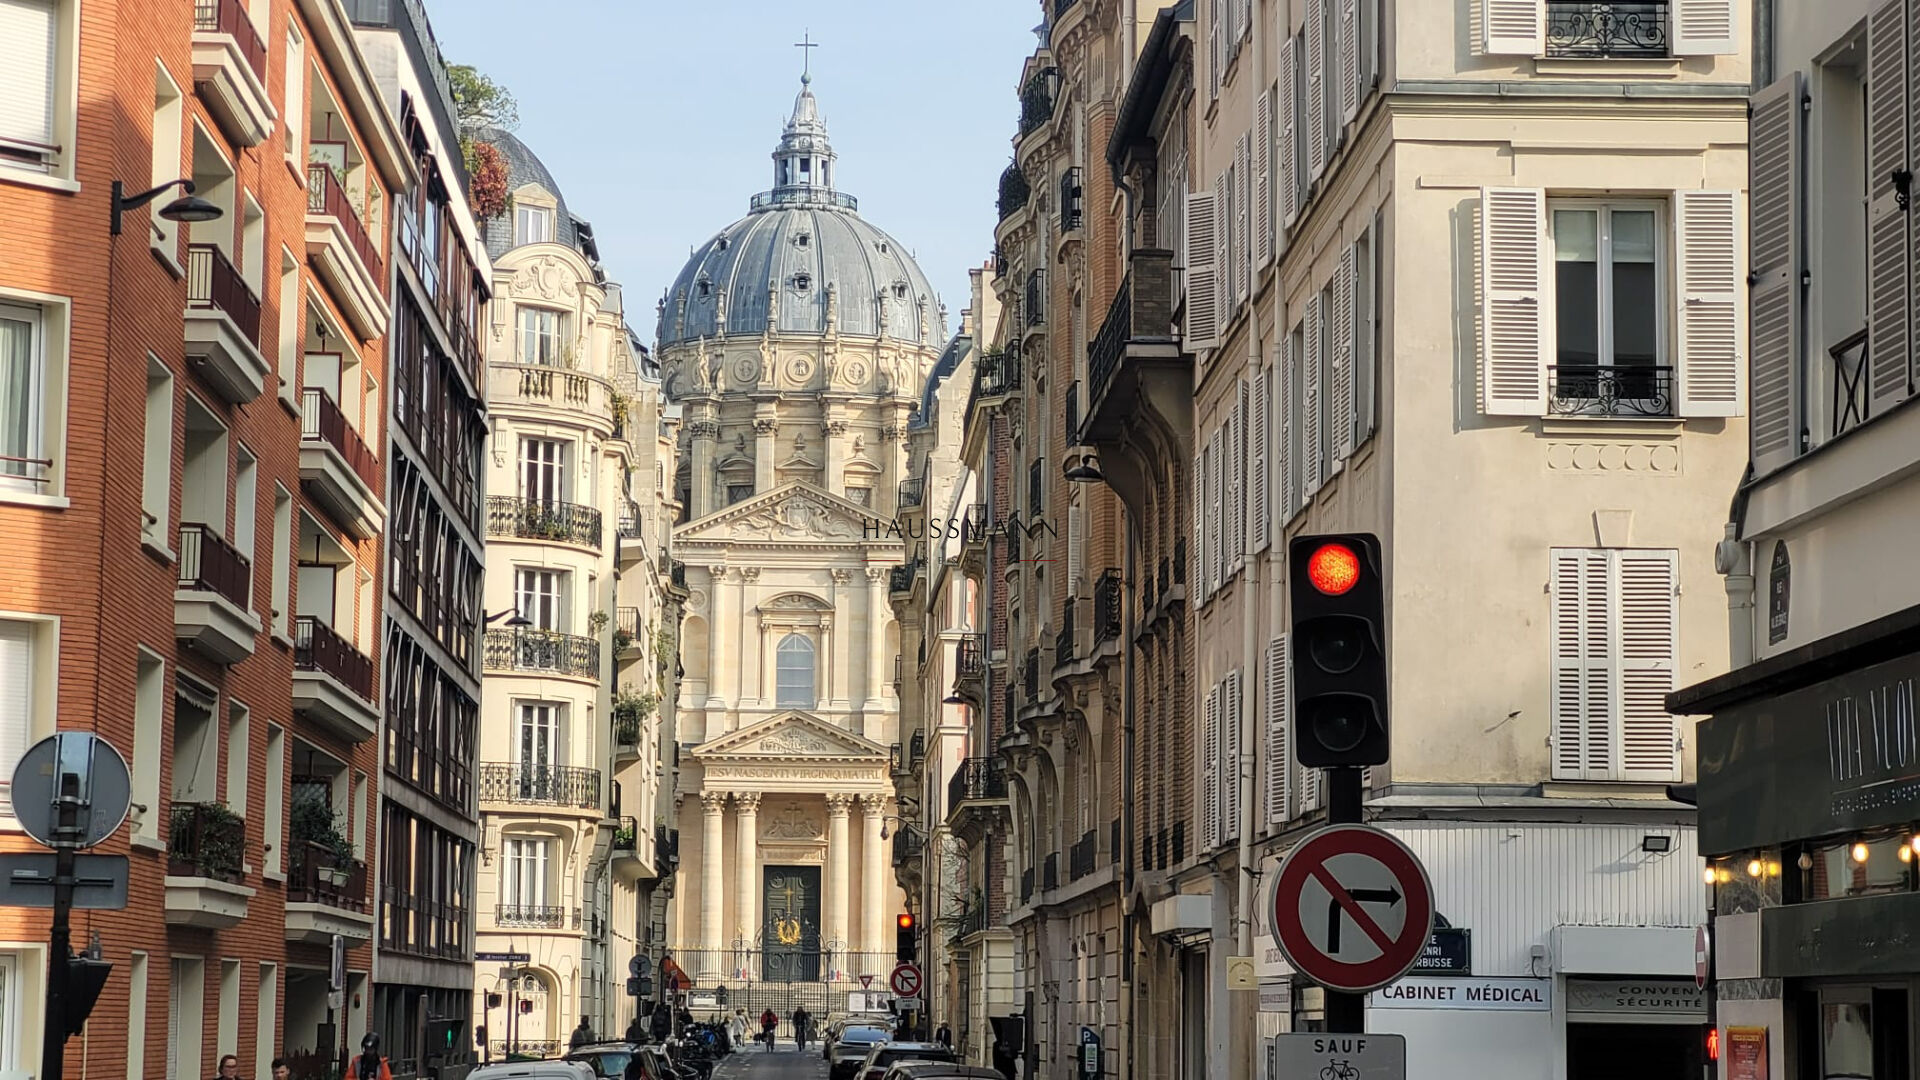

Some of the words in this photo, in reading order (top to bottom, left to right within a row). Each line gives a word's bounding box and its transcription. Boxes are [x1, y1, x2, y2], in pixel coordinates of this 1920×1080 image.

[1416, 958, 1452, 968] RBUSSE
[1382, 984, 1457, 1000] CABINET
[1466, 983, 1544, 1003] MÉDICAL
[1314, 1039, 1367, 1054] SAUF
